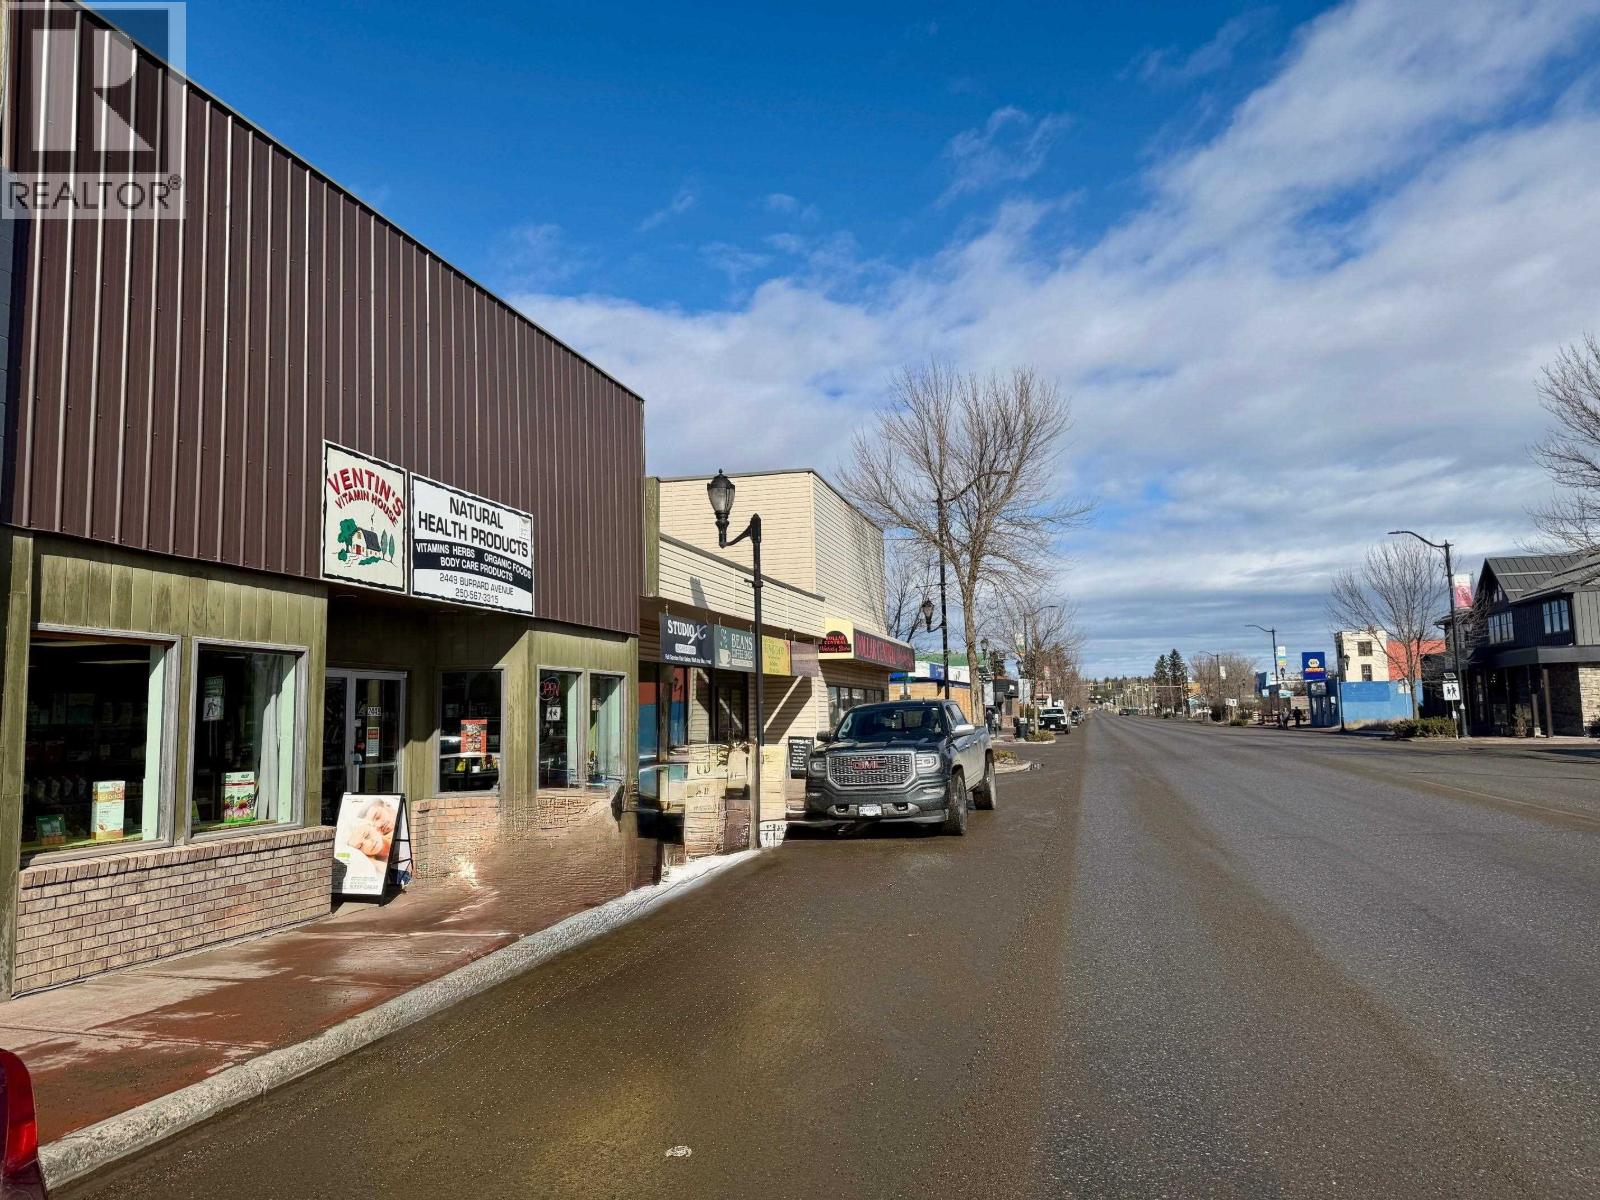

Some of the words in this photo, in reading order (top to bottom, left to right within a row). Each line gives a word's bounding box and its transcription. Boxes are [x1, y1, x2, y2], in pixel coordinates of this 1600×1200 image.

[327, 467, 404, 517] VENTIN'S
[335, 489, 370, 509] VITAMIN
[371, 492, 399, 527] HOUSE
[449, 496, 504, 530] NATURAL
[418, 510, 468, 542] HEALTH
[471, 526, 529, 558] PRODUCTS
[415, 542, 450, 555] VITAMINS
[452, 545, 476, 559] HERBS
[483, 552, 512, 570] ORGANIC
[512, 564, 532, 580] FOODS
[440, 556, 460, 568] BODY
[461, 559, 480, 572] CARE
[480, 563, 514, 582] PRODUCTS
[459, 576, 490, 592] BURRARD
[490, 583, 514, 596] AVENUE
[667, 619, 695, 638] STUDIO
[731, 633, 753, 651] BEANS
[852, 760, 887, 770] GMC
